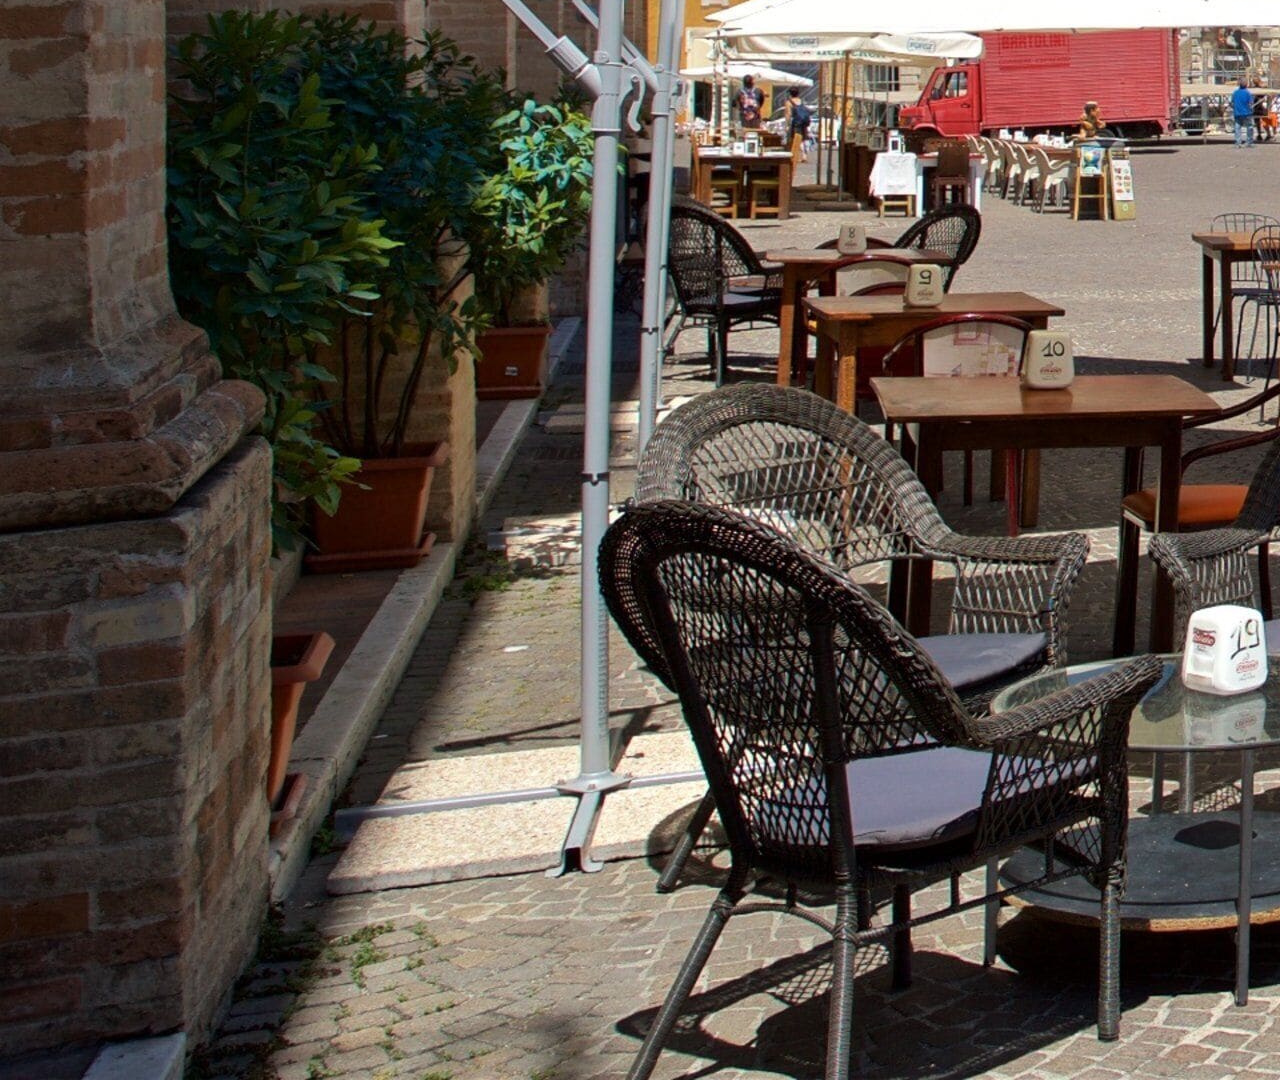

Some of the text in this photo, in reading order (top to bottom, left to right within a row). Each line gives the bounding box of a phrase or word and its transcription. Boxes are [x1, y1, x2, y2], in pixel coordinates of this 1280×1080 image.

[919, 269, 932, 285] 9
[1041, 340, 1065, 357] 10
[1230, 618, 1260, 660] 19
